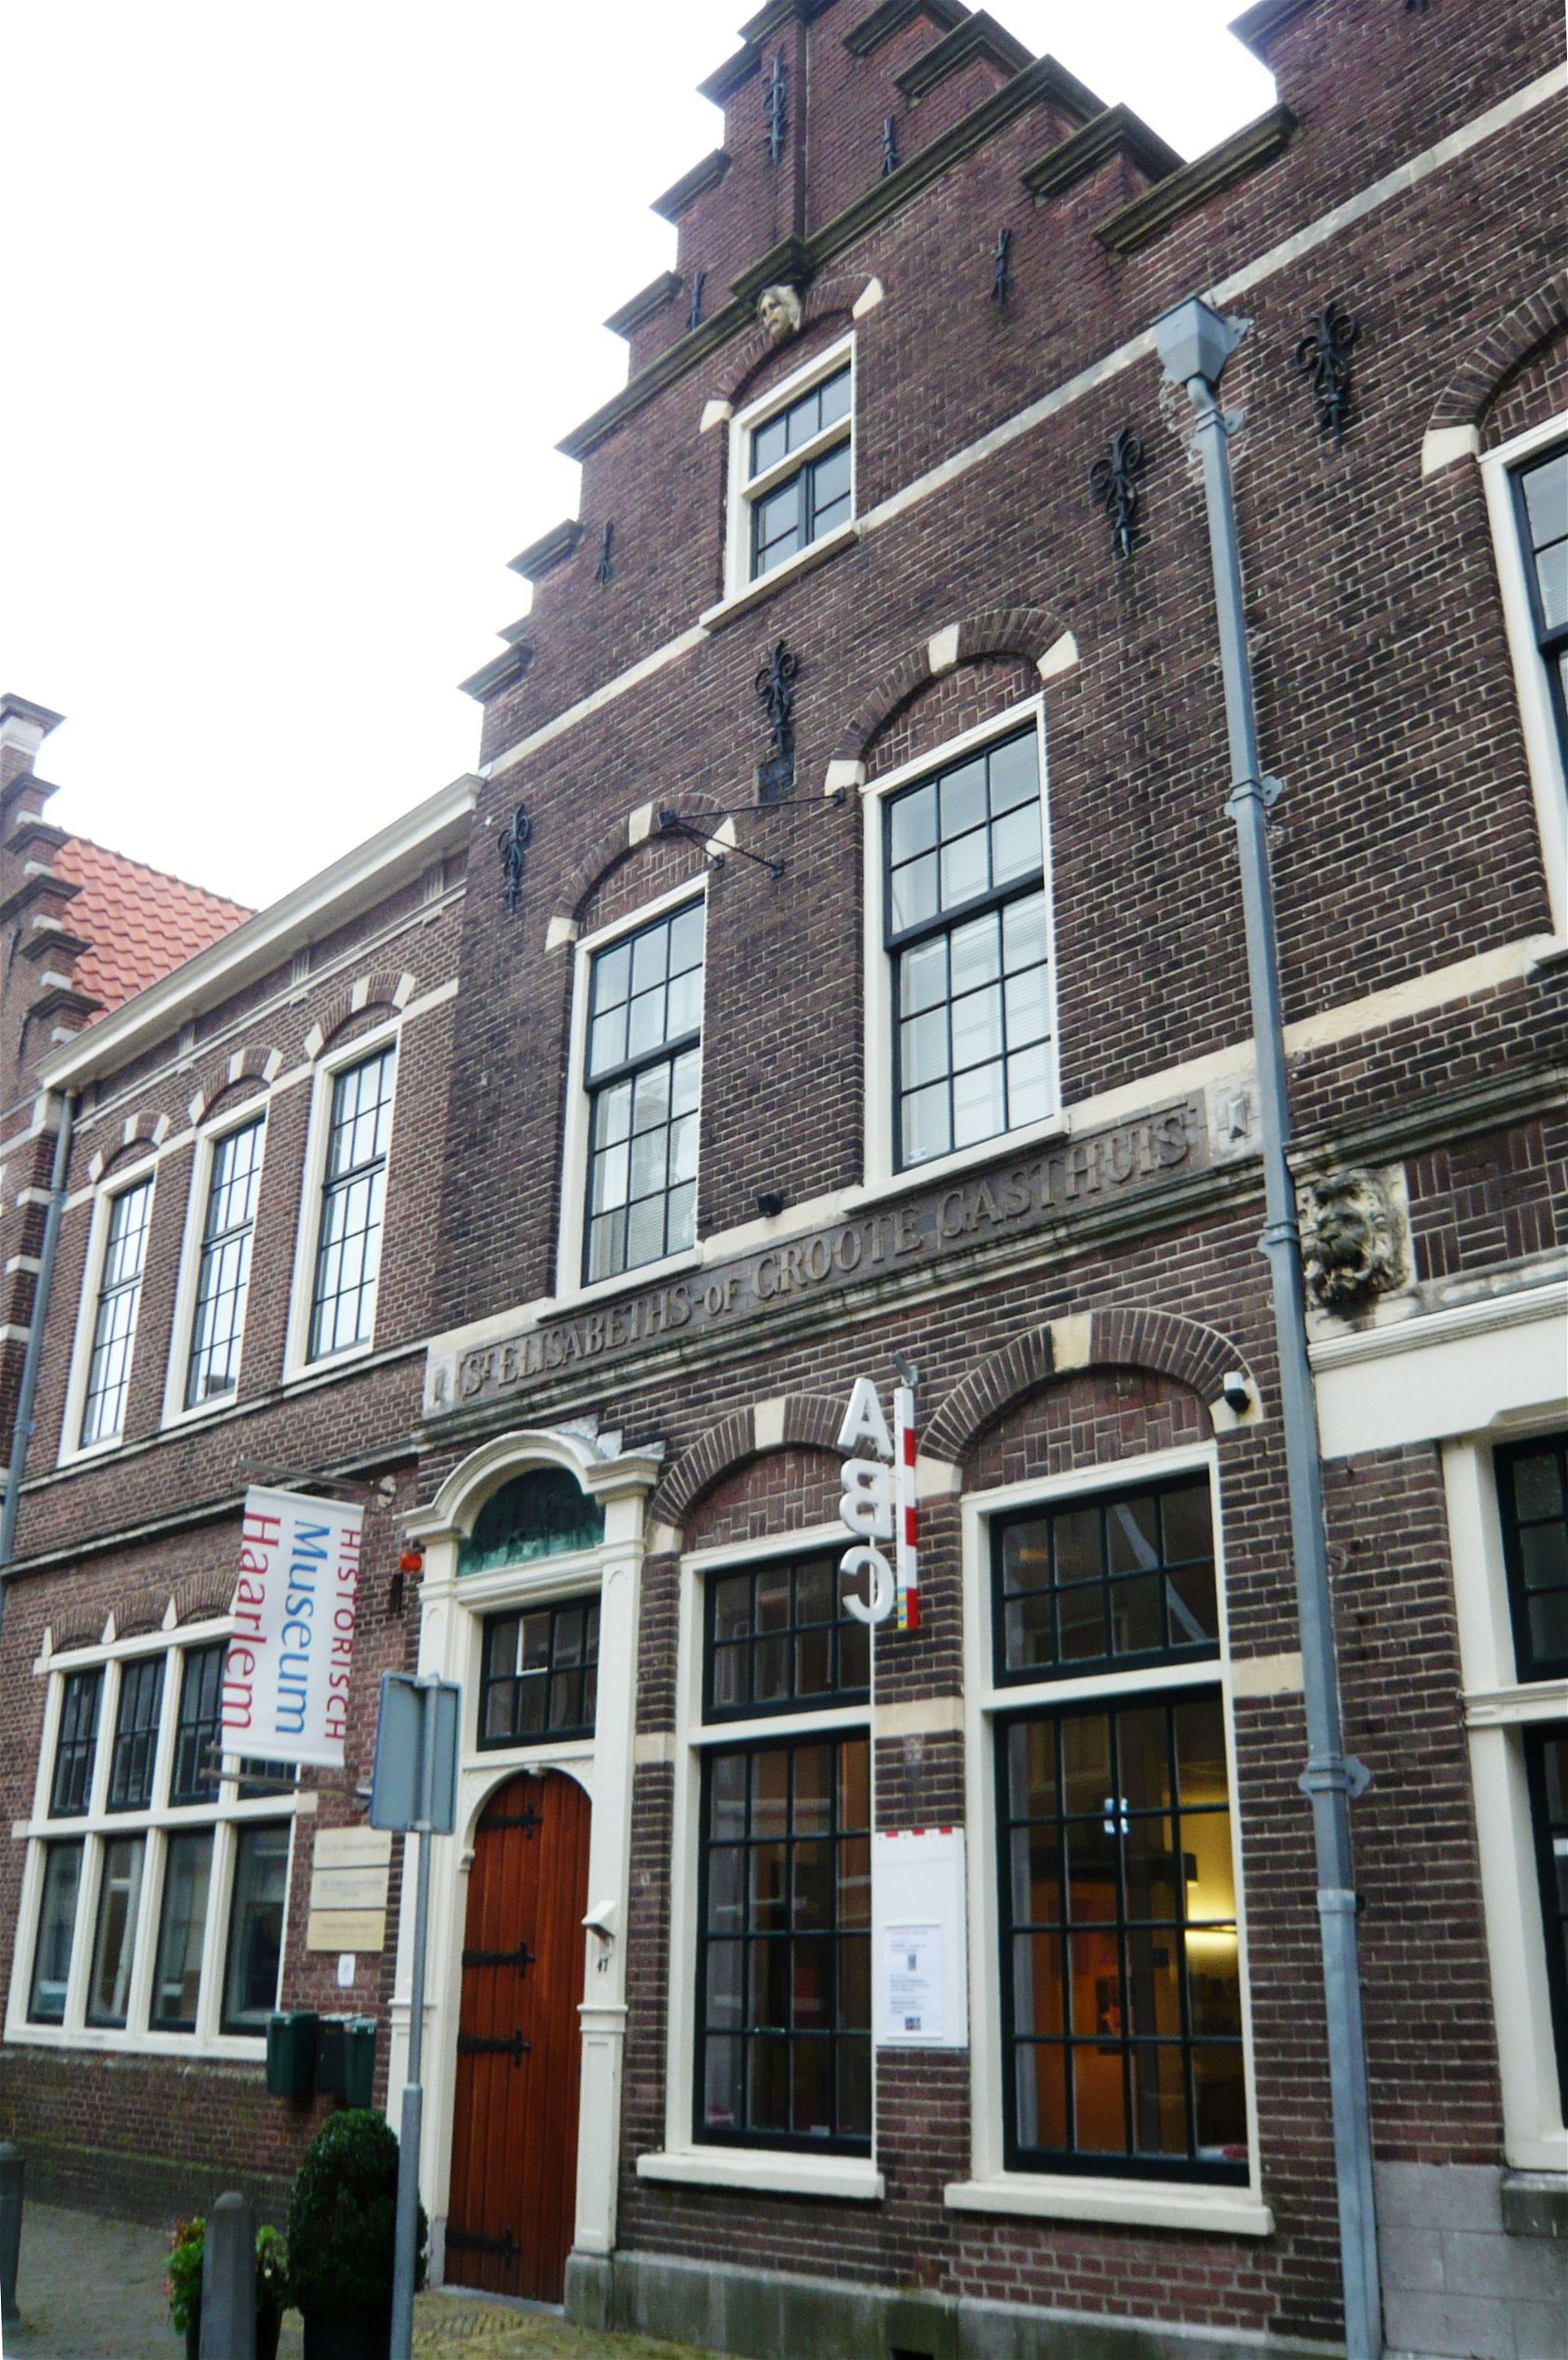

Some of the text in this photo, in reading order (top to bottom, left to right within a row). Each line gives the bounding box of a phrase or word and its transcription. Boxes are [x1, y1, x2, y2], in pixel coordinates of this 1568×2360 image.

[752, 1207, 924, 1301] GROOTE
[935, 1115, 1190, 1238] GASTHUIS
[220, 1511, 281, 1731] Haarlem
[274, 1520, 331, 1735] Museum
[324, 1528, 362, 1741] HISTORISCH
